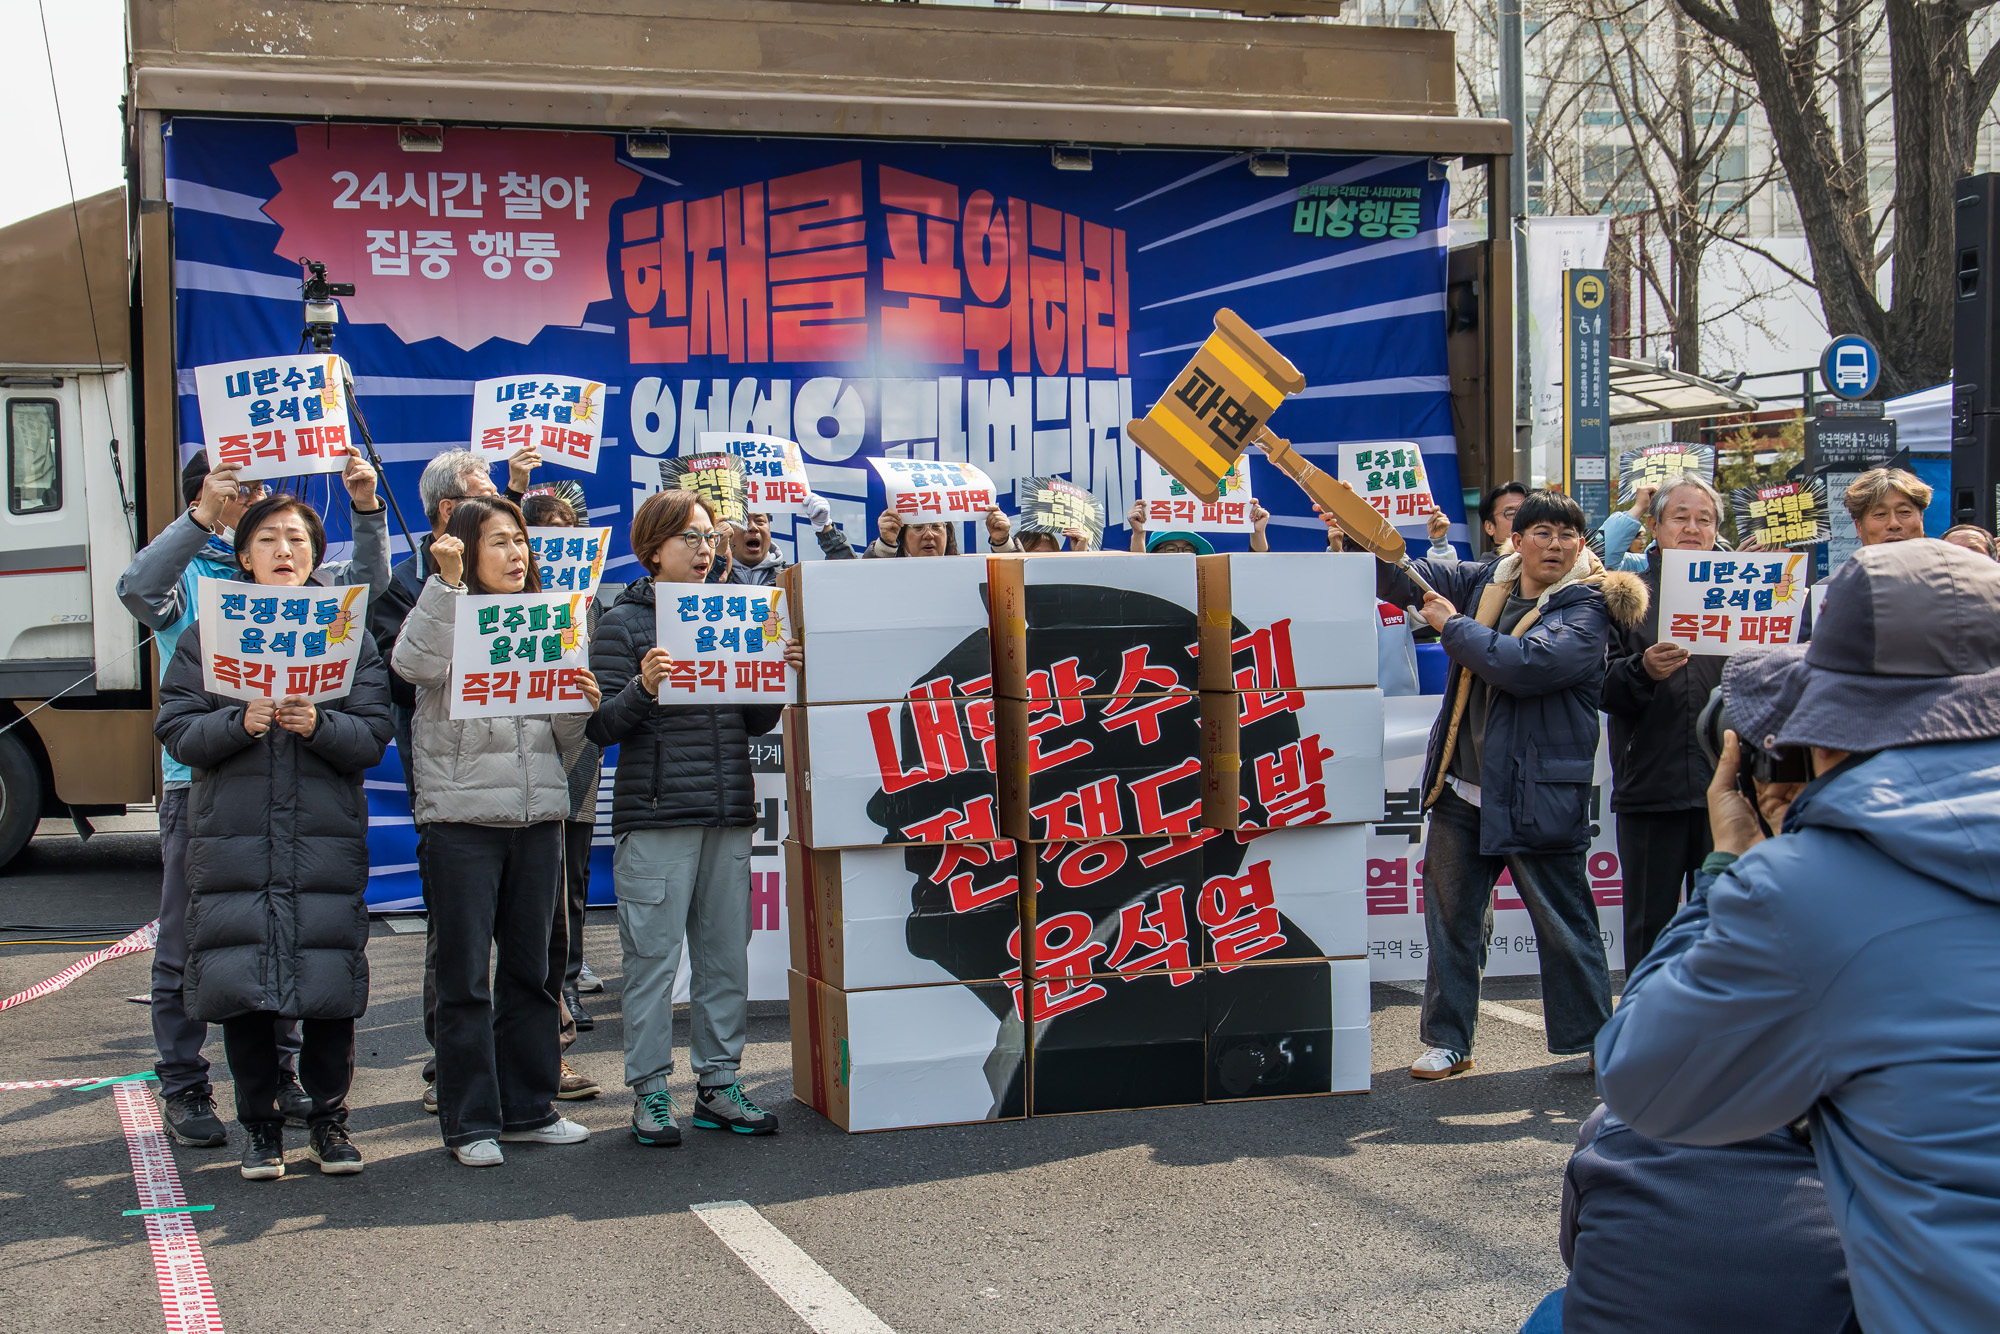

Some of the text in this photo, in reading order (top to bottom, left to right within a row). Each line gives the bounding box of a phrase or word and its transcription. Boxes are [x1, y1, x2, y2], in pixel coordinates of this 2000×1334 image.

[331, 170, 590, 221] 24시간 철야
[1293, 197, 1421, 239] 비상행동
[366, 229, 561, 281] 집중 행동
[621, 159, 1130, 376] 헌재를 포위하라
[1580, 339, 1588, 361] 노약자
[225, 365, 326, 398] 내란수괴
[496, 381, 582, 403] 내란수괴
[1592, 358, 1600, 407] 무료셔틀버스
[248, 394, 324, 427] 윤석열
[508, 403, 572, 424] 윤석열
[1174, 366, 1258, 451] 파면
[1835, 402, 1860, 411] 금연구역
[1580, 418, 1600, 428] 안국역
[219, 425, 349, 466] 즉각 파면
[481, 424, 595, 459] 즉각 파면
[726, 441, 785, 458] 내란수괴
[887, 461, 962, 472] 전쟁책동
[1355, 449, 1418, 471] 민주파괴
[679, 468, 741, 491] 윤석열을
[747, 481, 807, 503] 각 파면
[911, 473, 967, 487] 윤석열
[1366, 469, 1418, 491] 윤석열
[895, 489, 990, 516] 즉각 파면
[1038, 489, 1095, 522] 윤석열을
[1150, 500, 1247, 525] 즉각 파면
[1370, 492, 1435, 518] 각 파면
[1749, 492, 1815, 519] 윤석열을
[1755, 520, 1818, 545] 파면하라
[540, 565, 592, 591] 윤석열
[1688, 561, 1783, 584] 내란수괴
[220, 593, 339, 626] 전쟁책동
[676, 594, 770, 622] 전쟁책동
[1703, 587, 1774, 611] 윤석열
[50, 614, 88, 623] G270
[478, 602, 572, 634] 민주파괴
[1670, 613, 1796, 644] 즉각 파면
[239, 628, 328, 657] 윤석열
[489, 634, 563, 665] 윤석열
[695, 625, 764, 653] 윤석열
[213, 654, 347, 697] 즉각 파면
[461, 668, 585, 706] 즉각 파면
[668, 659, 786, 693] 즉각 파면
[866, 618, 1306, 795] 내란수괴
[900, 733, 1334, 914] 전쟁도발
[998, 858, 1288, 1024] 윤석열
[1367, 940, 1403, 959] 국역
